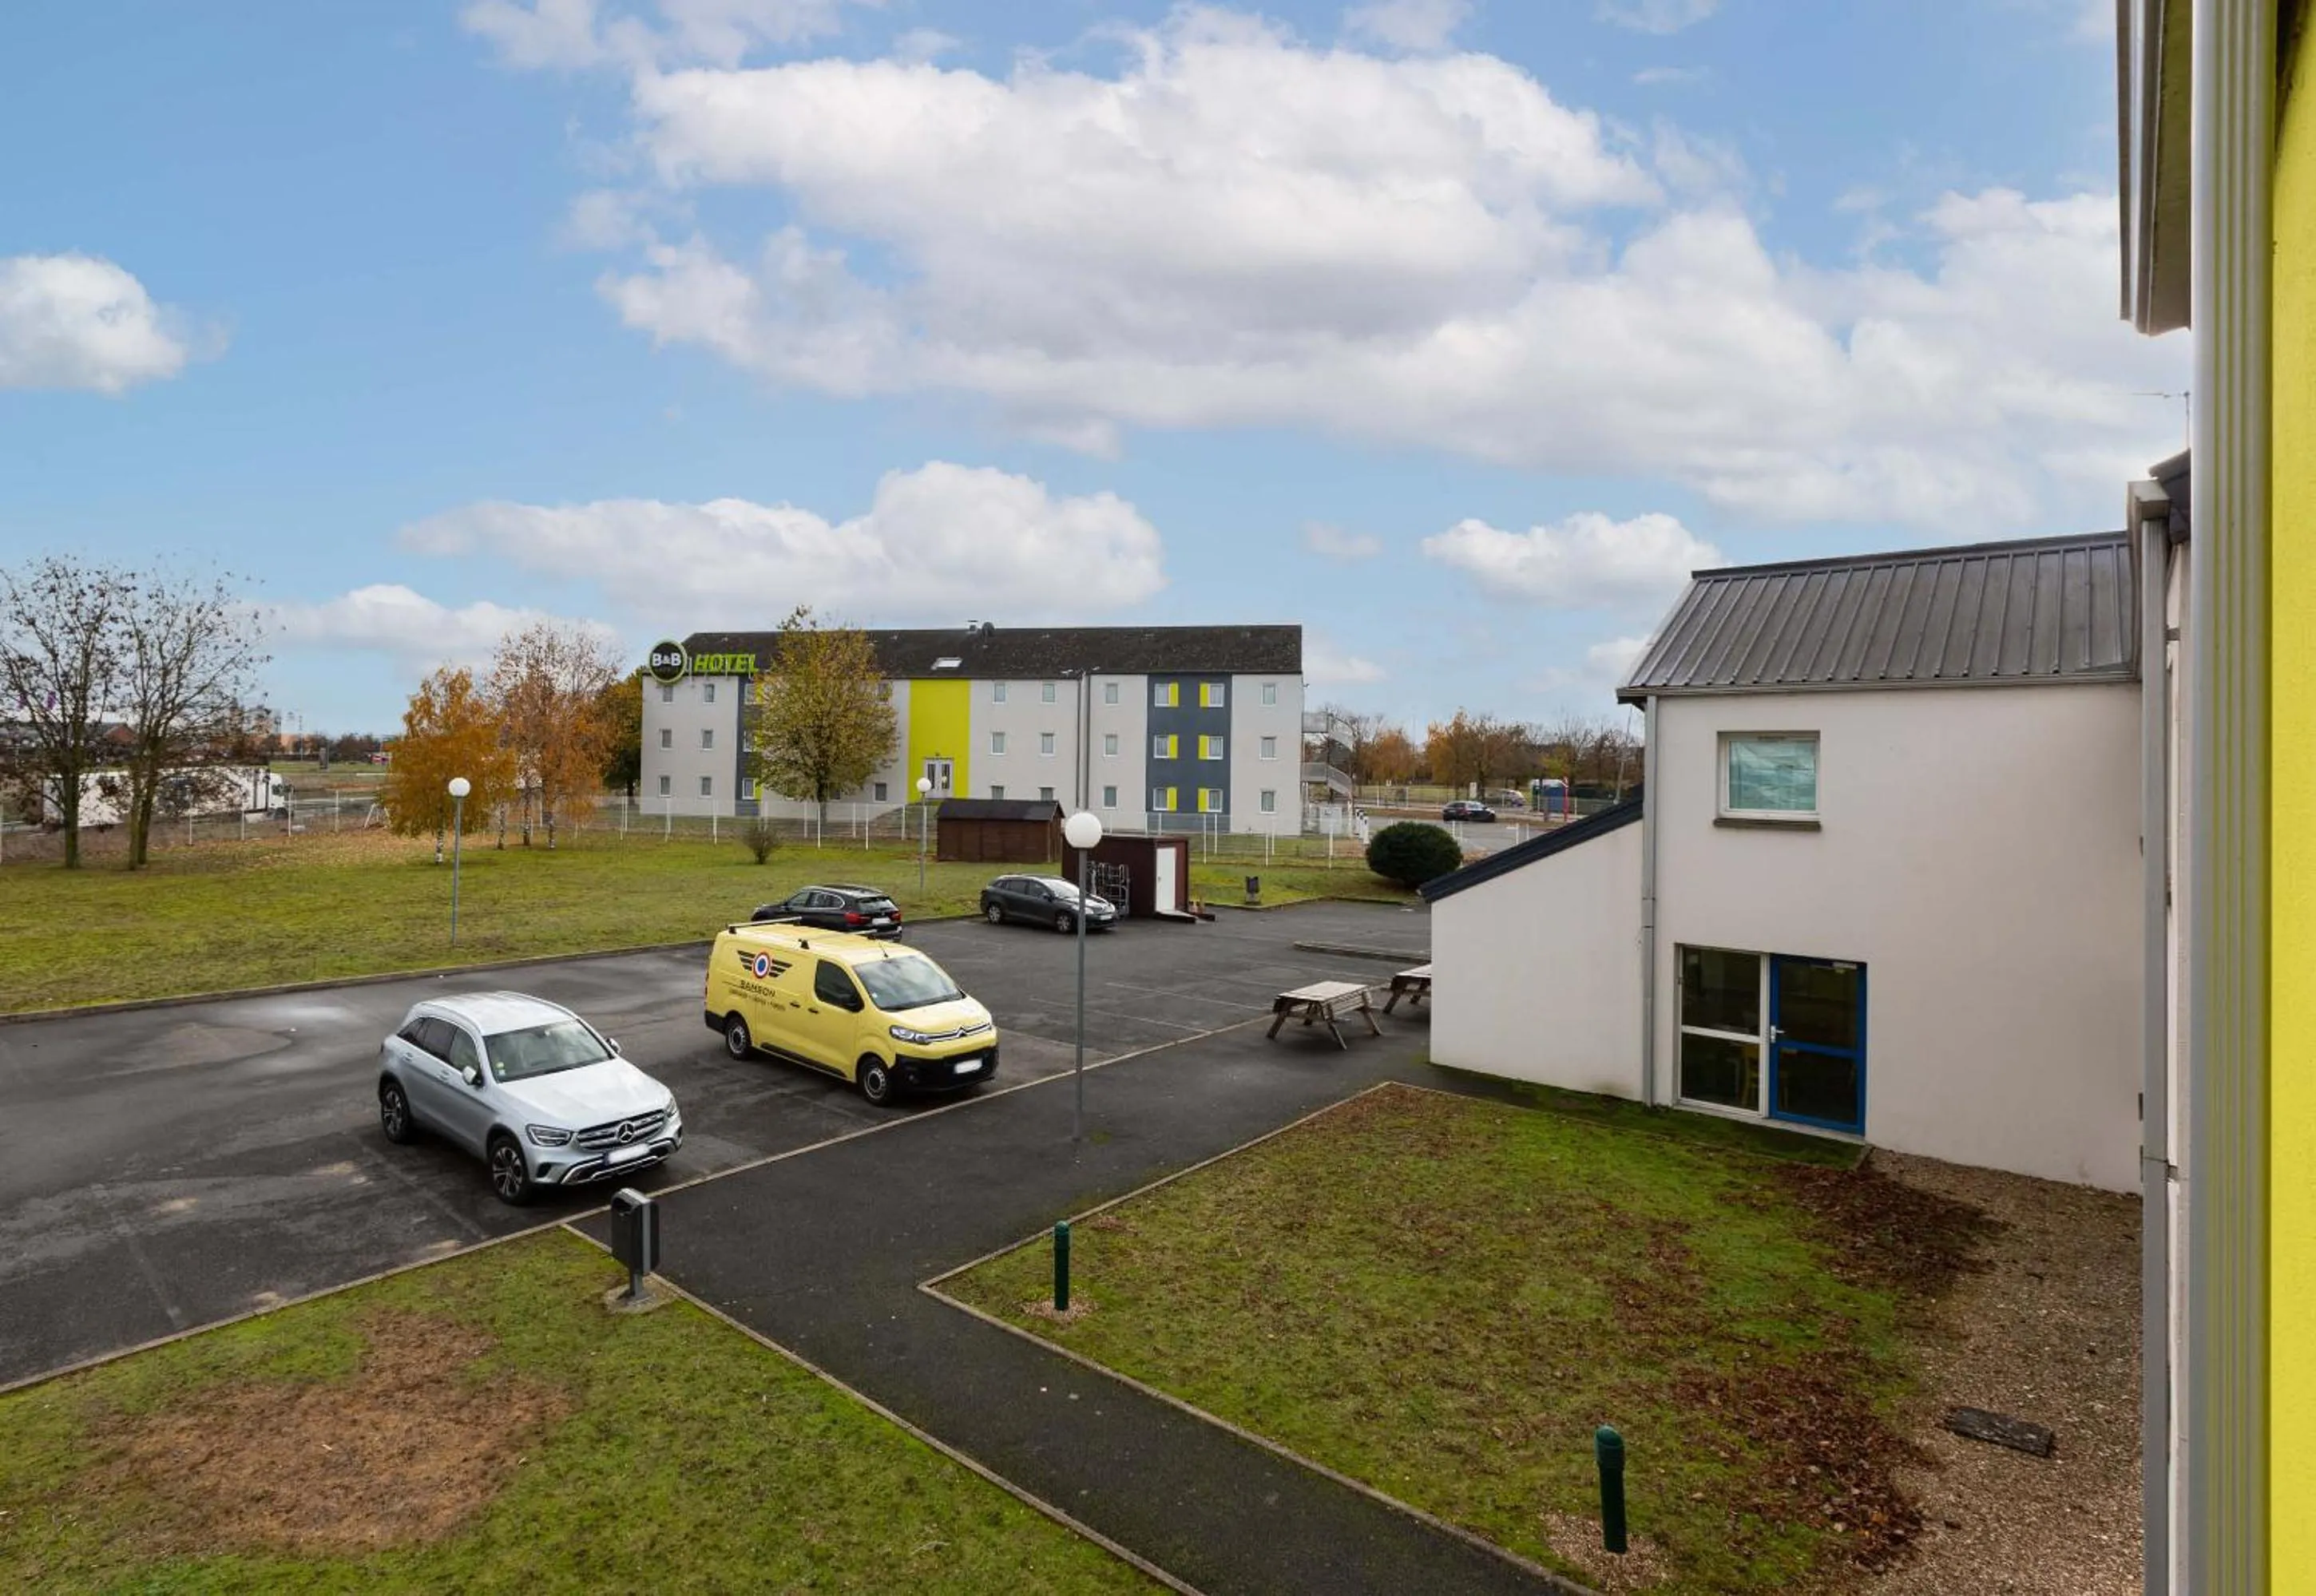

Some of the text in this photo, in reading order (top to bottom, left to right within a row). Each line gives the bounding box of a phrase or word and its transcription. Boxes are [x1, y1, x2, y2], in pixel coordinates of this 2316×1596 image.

[652, 652, 759, 672] B&B HOTEL
[740, 980, 775, 997] SAMSON
